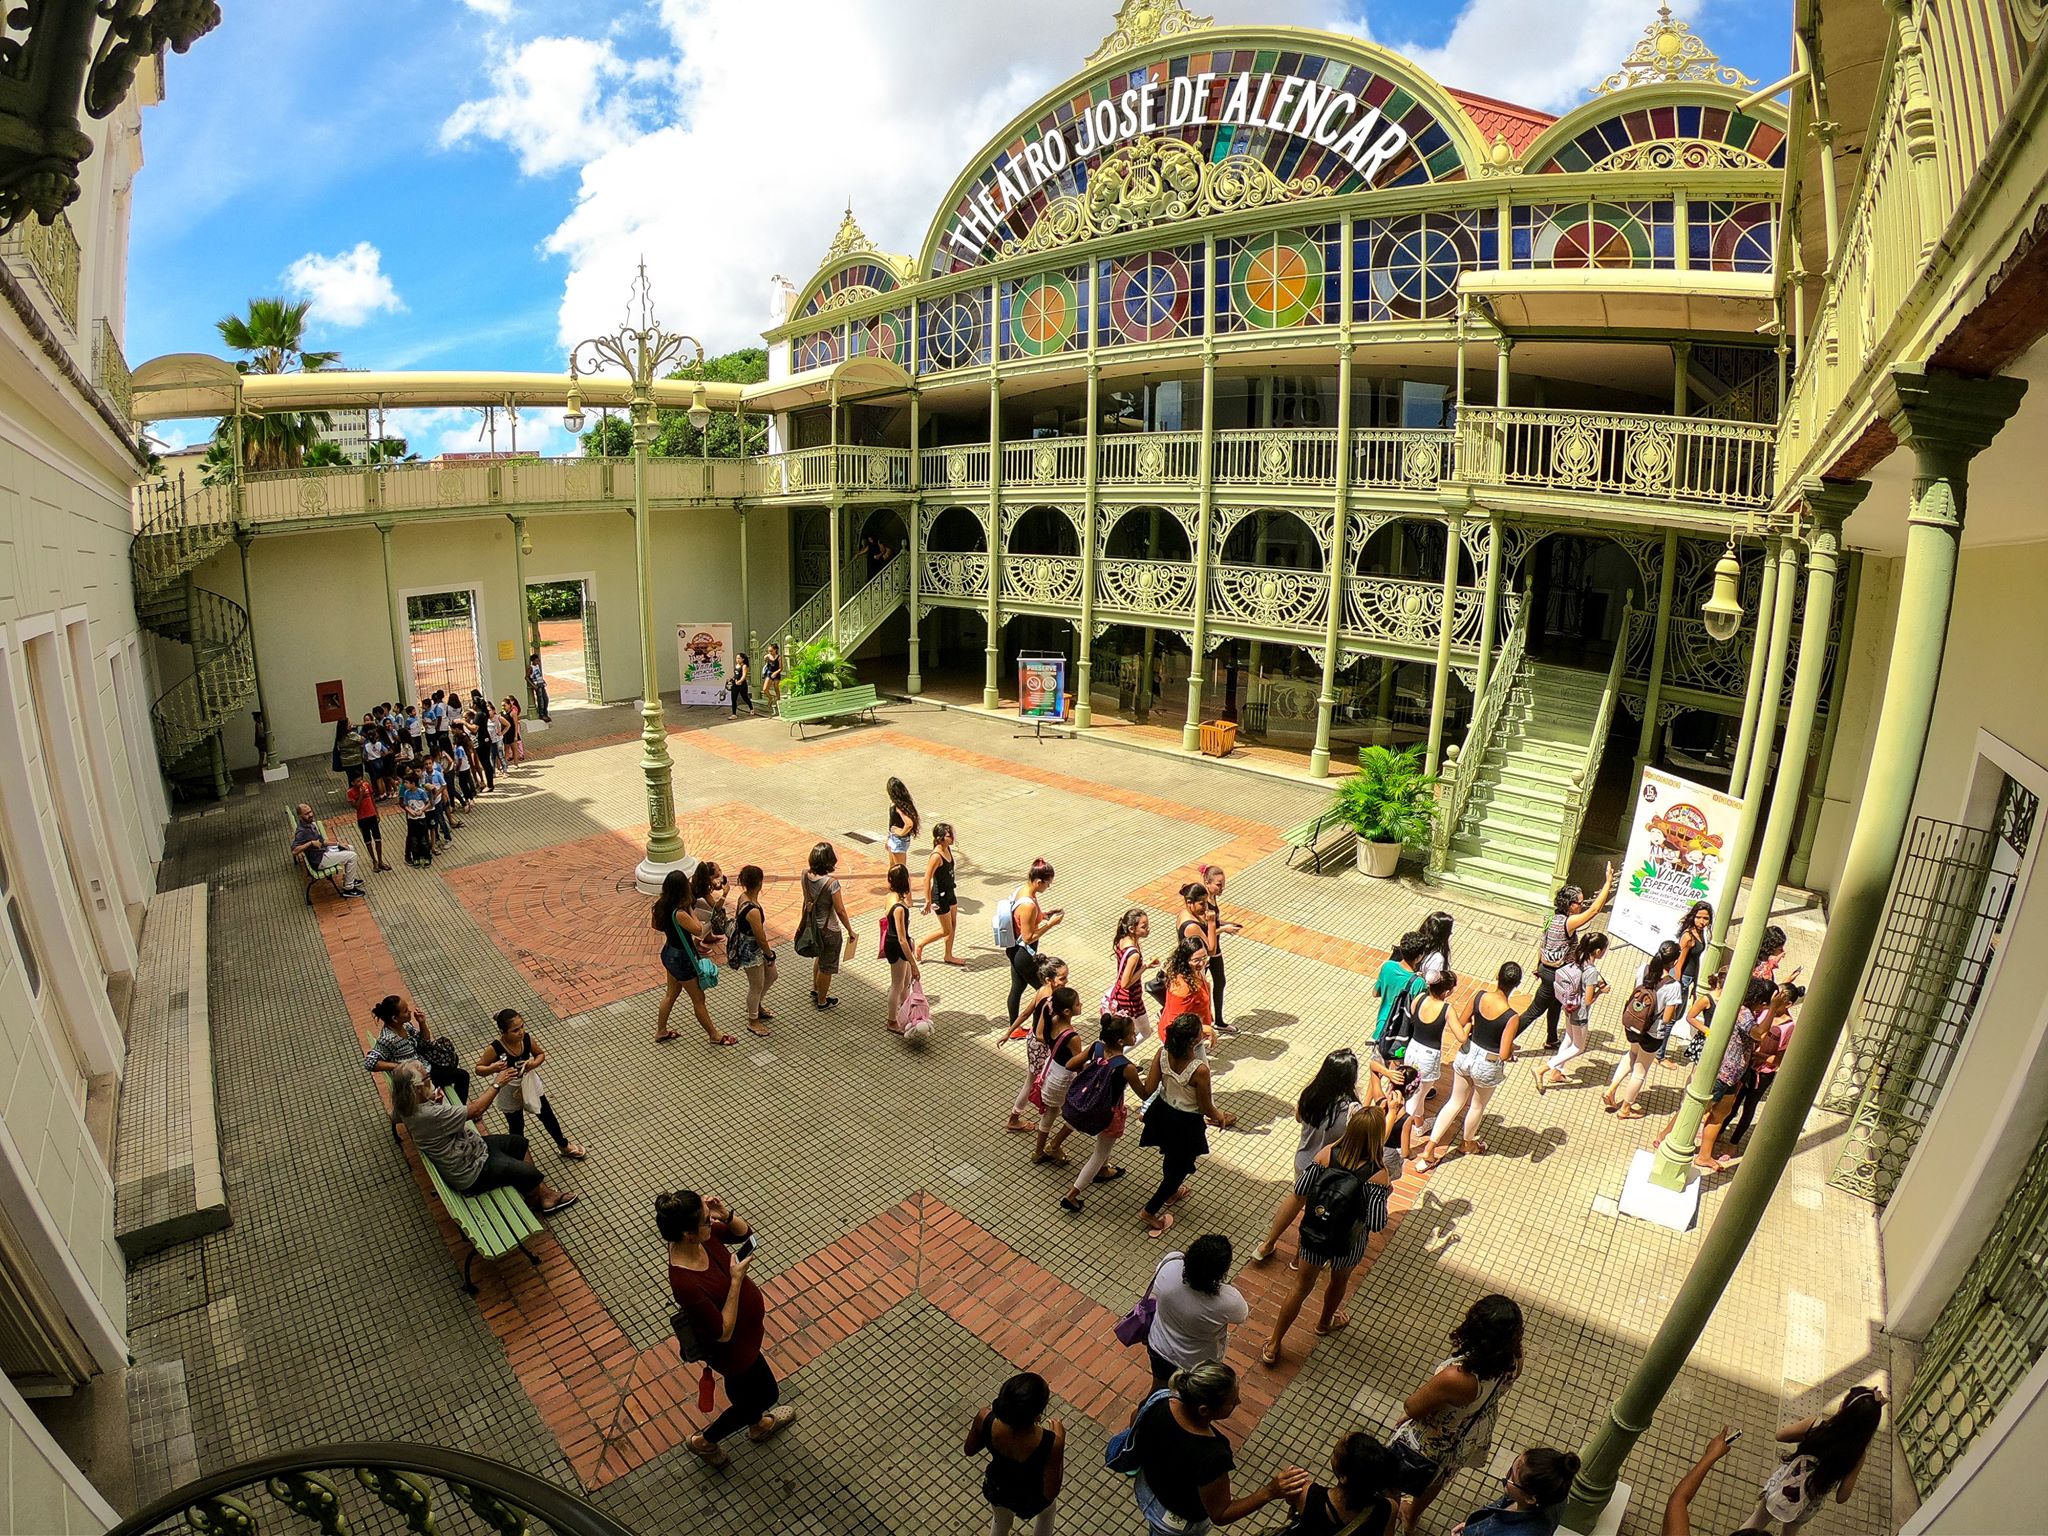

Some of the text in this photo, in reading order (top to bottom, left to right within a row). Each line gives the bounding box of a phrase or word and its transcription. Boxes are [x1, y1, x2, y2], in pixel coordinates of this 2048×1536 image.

[950, 72, 1407, 256] THEATRO JOSÉ DE ALENCAR
[1657, 867, 1691, 886] VISITA
[1643, 877, 1701, 899] ESPETACULAR
